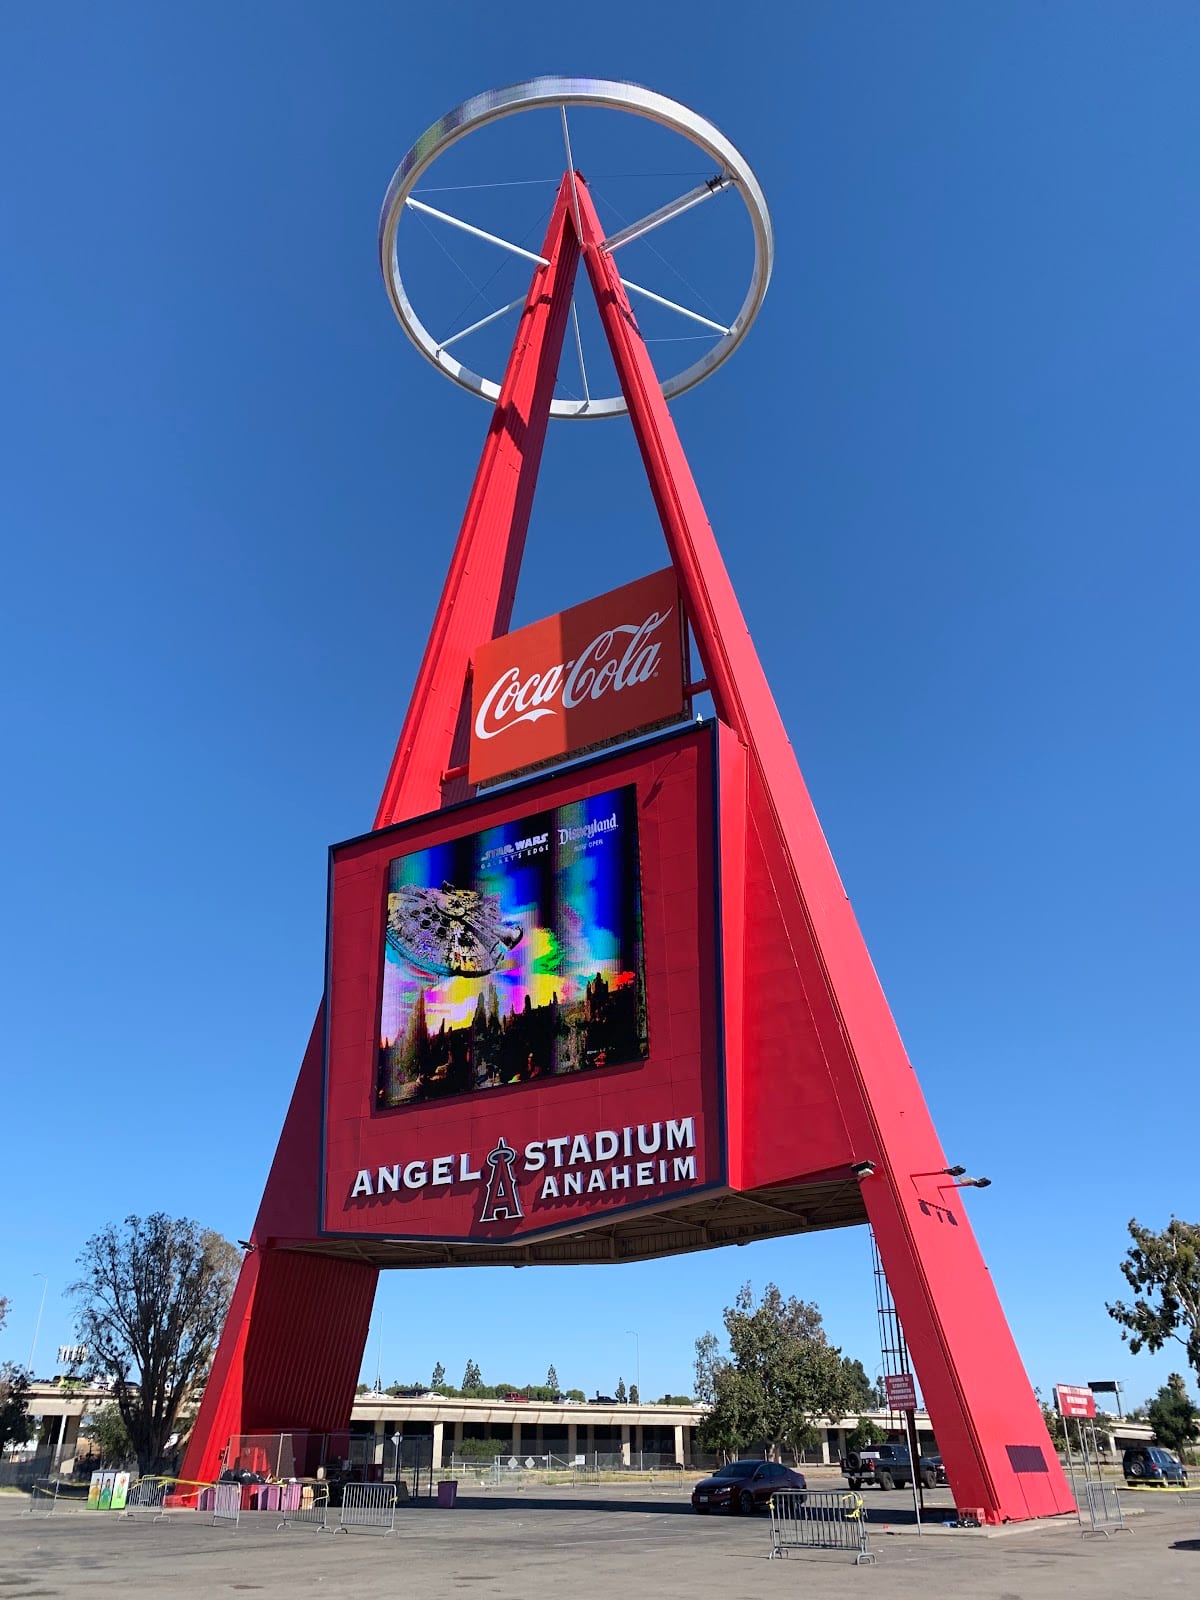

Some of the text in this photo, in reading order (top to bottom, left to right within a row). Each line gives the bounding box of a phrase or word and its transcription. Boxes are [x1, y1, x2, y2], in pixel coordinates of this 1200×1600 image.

[475, 605, 674, 740] Coca-Cola
[557, 813, 617, 845] Disneyland
[588, 839, 603, 848] OPEN
[481, 832, 549, 861] STAR WARS
[527, 845, 549, 856] EDGE
[351, 1117, 695, 1198] ANGEL STADIUM
[541, 1155, 696, 1199] ANAHEIM
